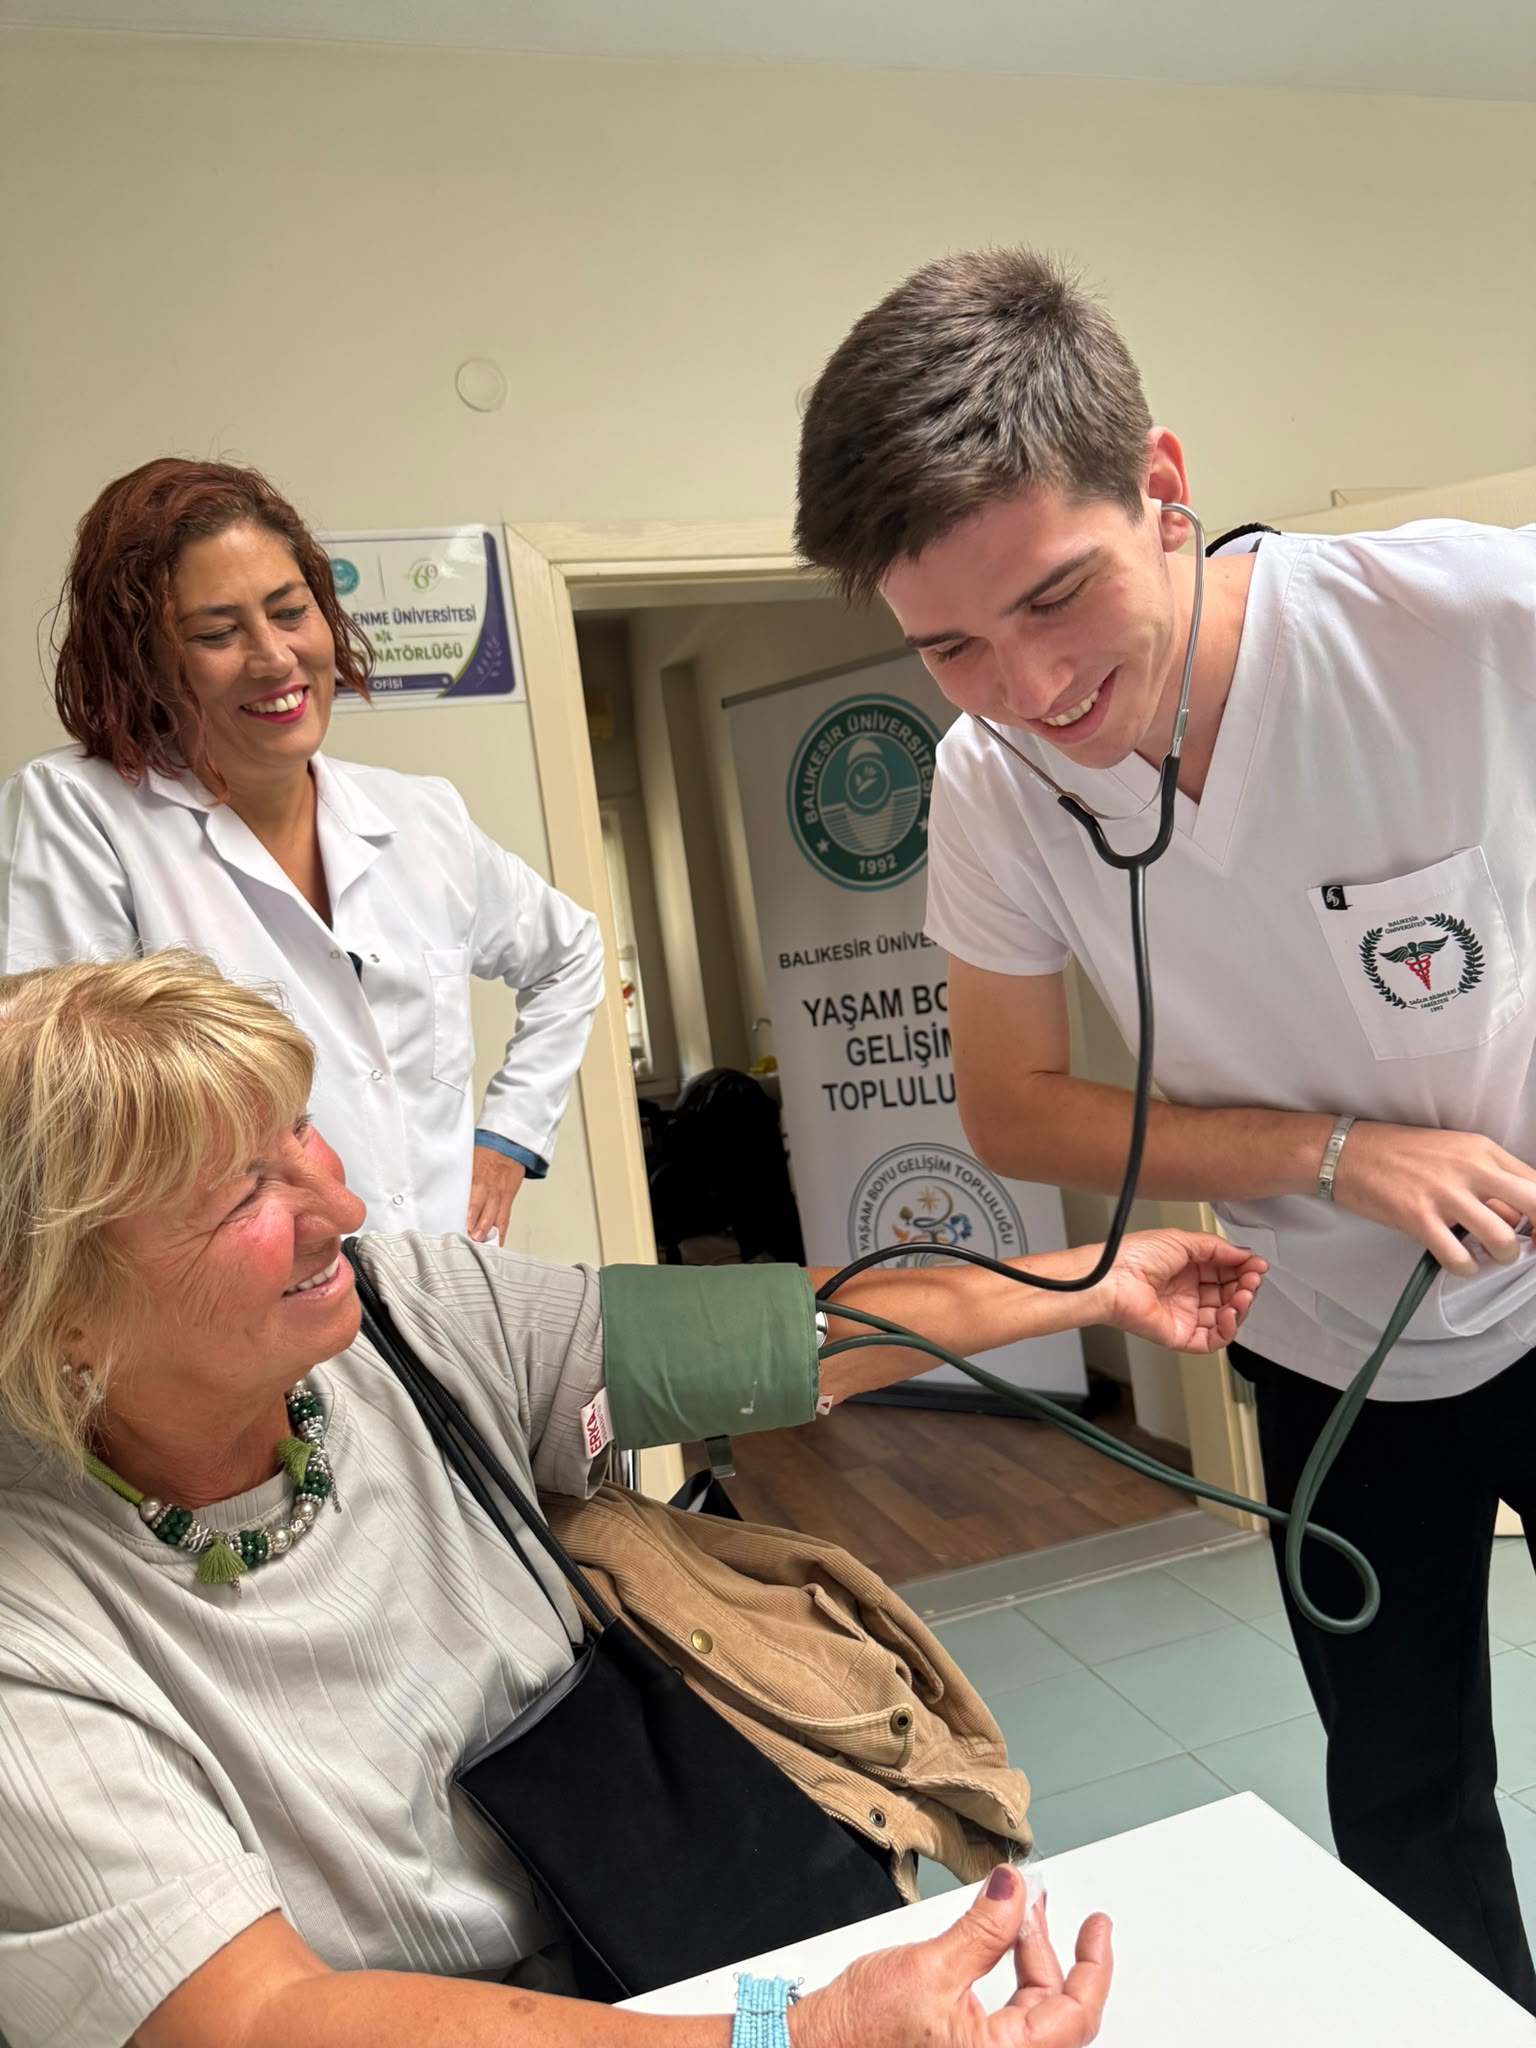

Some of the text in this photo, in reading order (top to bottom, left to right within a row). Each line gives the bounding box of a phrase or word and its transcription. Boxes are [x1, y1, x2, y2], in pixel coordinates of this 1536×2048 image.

[393, 604, 477, 625] ÜNİVERSİTESİ
[802, 724, 845, 825] BALIKESİR
[858, 853, 898, 875] 1992
[779, 930, 937, 969] BALIKESİR ÜNİVE
[803, 987, 904, 1031] YAŞAM
[822, 1073, 956, 1111] TOPLULU
[857, 1153, 1014, 1251] YAŞAM BOYU GELİŞİM TOPLULUĞU
